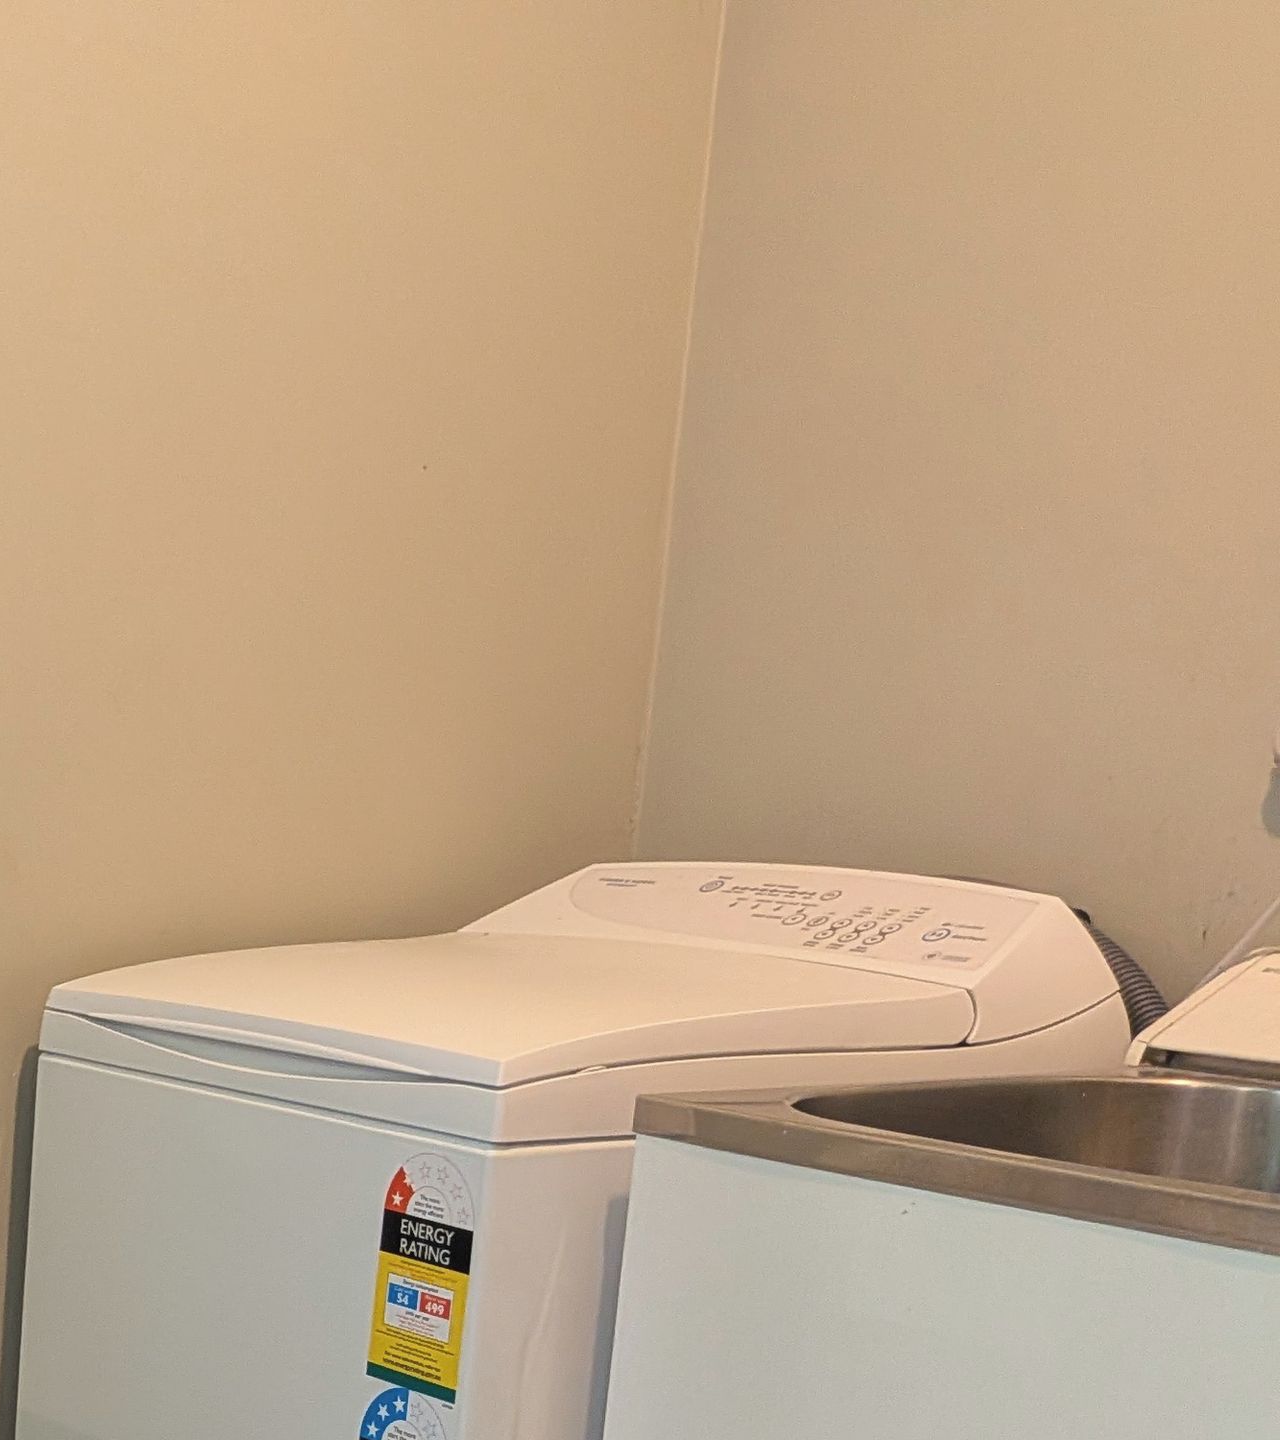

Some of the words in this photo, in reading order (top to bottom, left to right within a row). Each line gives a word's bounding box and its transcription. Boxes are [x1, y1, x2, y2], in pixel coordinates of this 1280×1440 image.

[400, 1219, 455, 1246] ENERGY
[399, 1238, 451, 1265] RATING
[425, 1301, 445, 1316] 499
